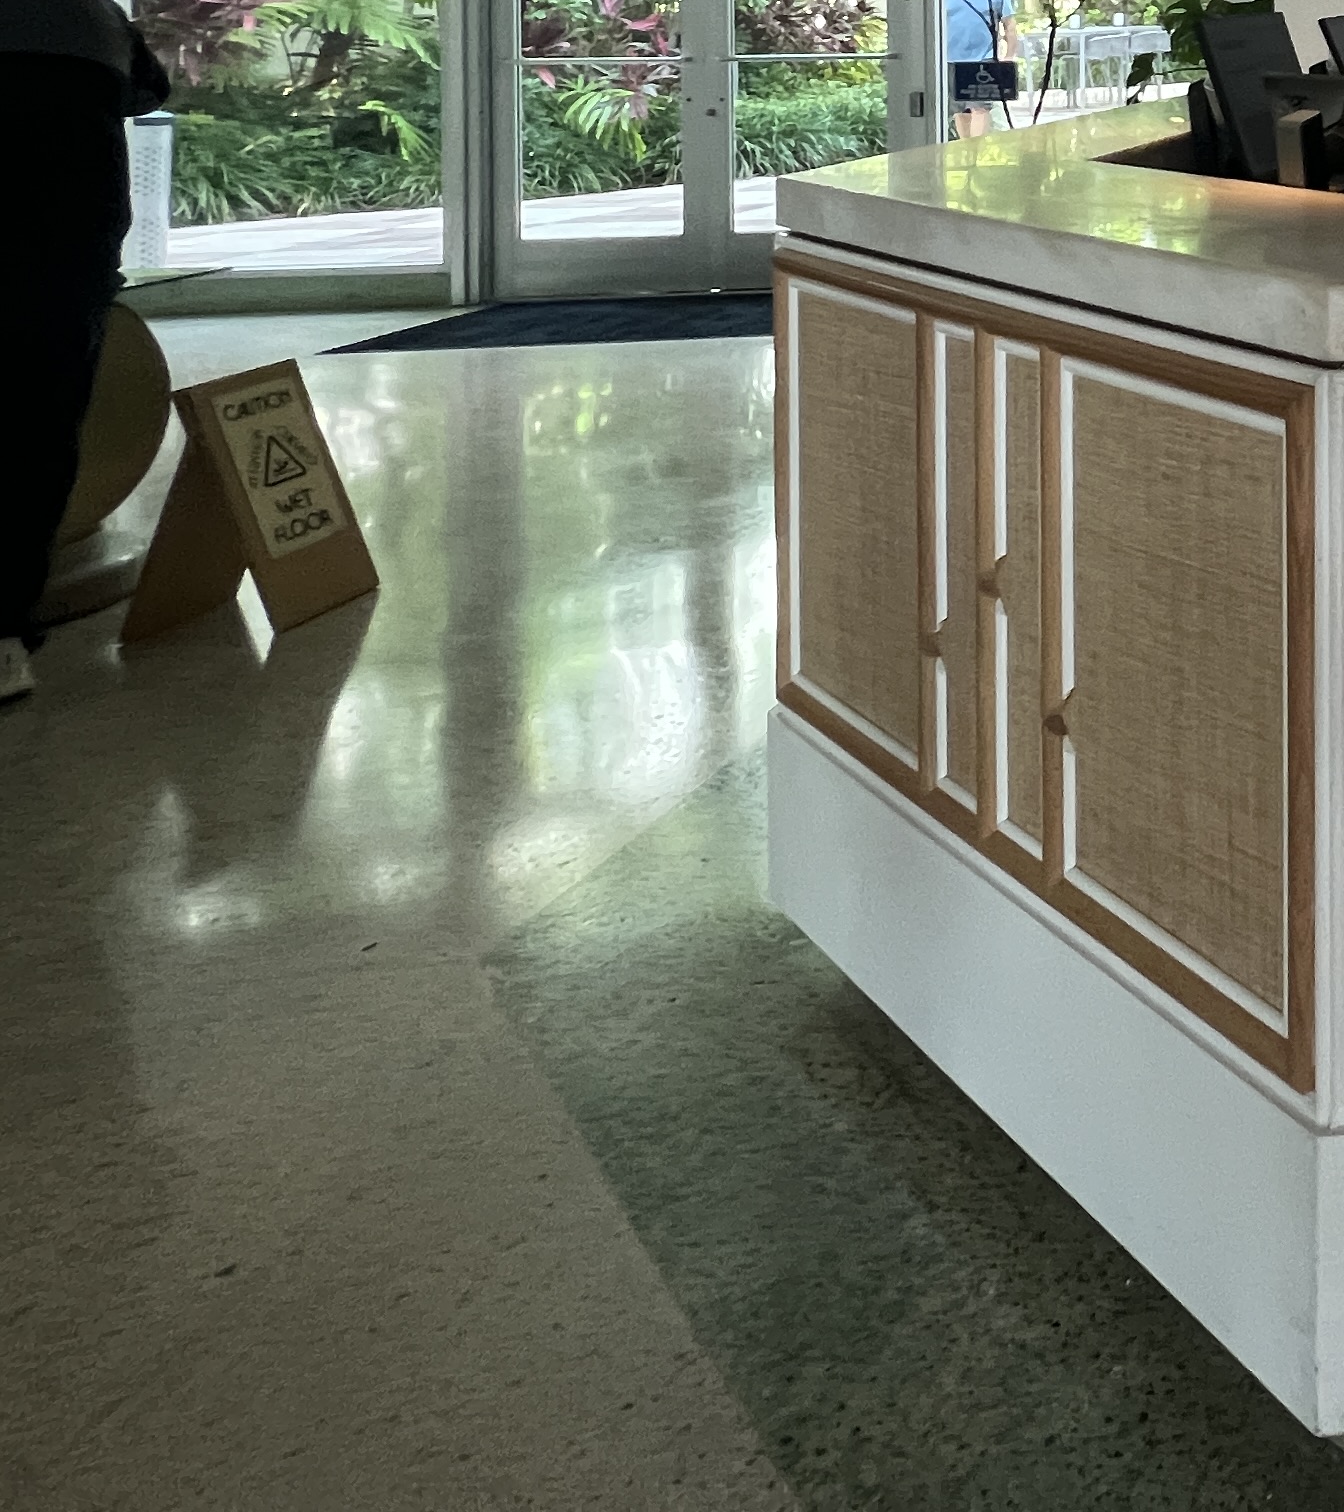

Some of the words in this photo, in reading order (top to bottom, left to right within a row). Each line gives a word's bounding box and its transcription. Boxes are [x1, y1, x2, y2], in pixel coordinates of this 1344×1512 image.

[222, 389, 292, 422] CAUTION
[274, 488, 313, 513] WET
[273, 509, 333, 544] FLOOR
